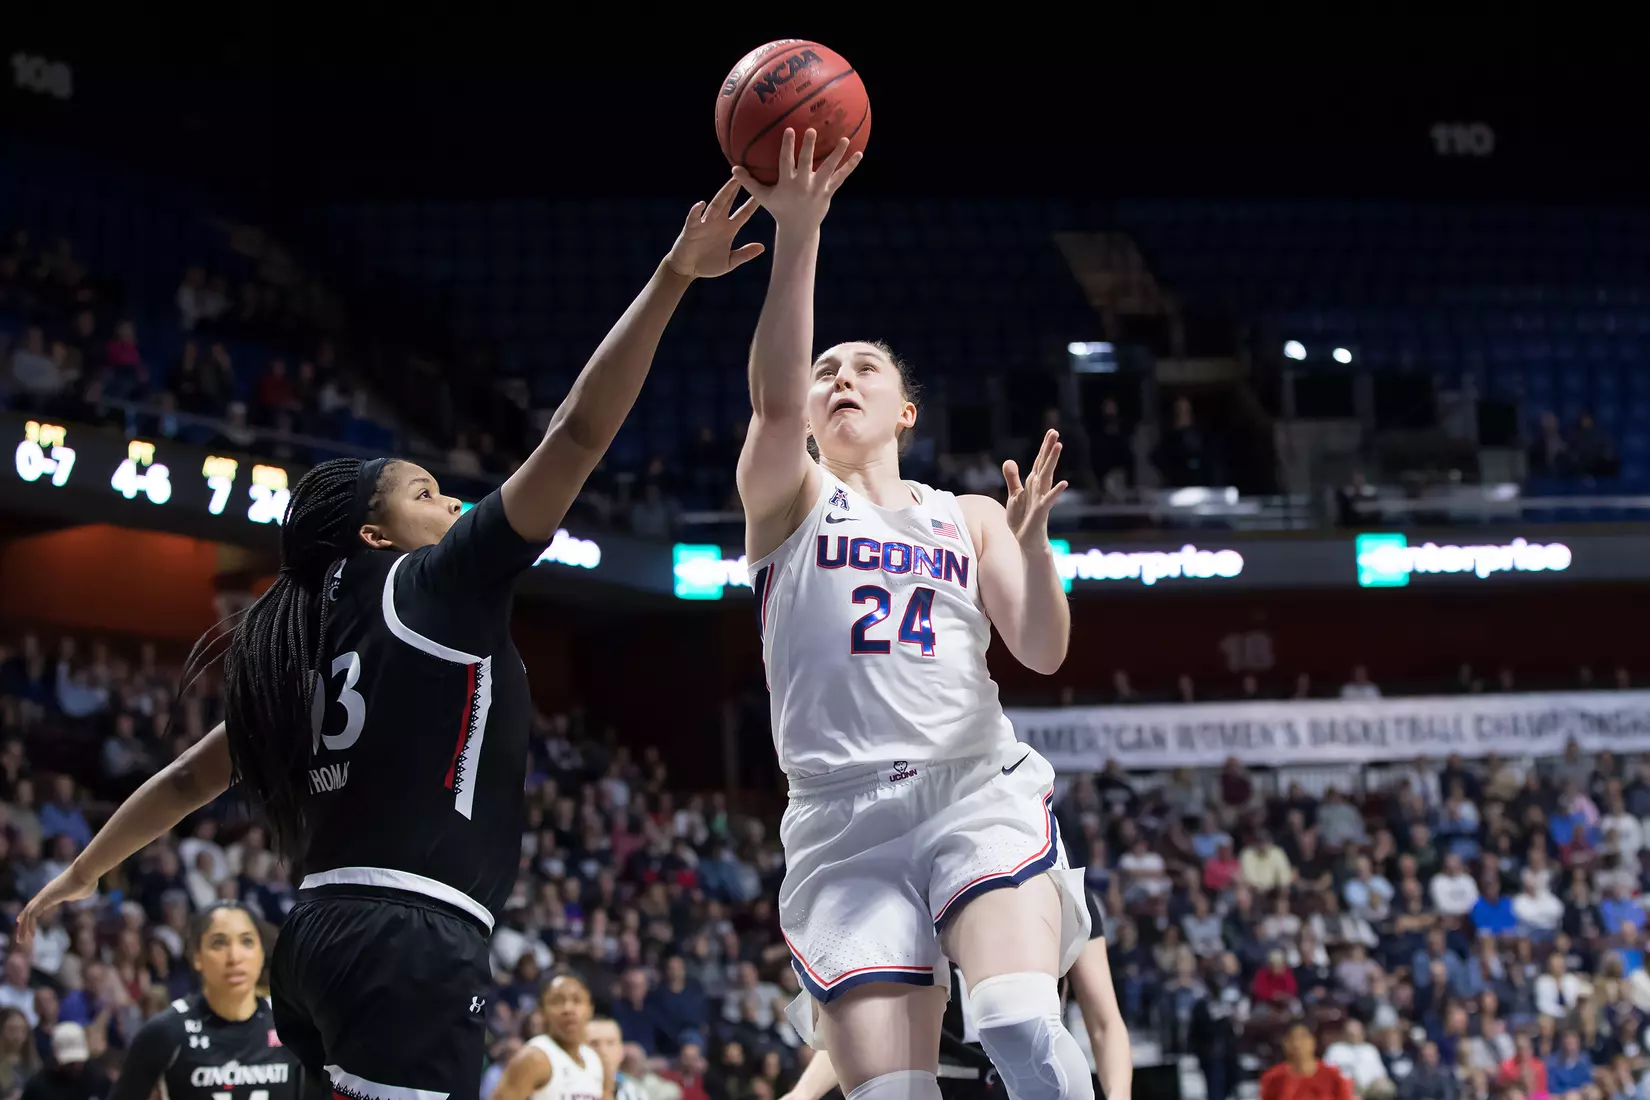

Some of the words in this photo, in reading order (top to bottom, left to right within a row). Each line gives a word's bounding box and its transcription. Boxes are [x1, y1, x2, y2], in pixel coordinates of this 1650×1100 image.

[752, 49, 824, 104] NCAA
[1430, 122, 1496, 157] 110
[15, 440, 76, 487] 0-7
[111, 458, 171, 504] 4-6
[207, 475, 232, 515] 7
[816, 535, 969, 589] UCONN
[850, 585, 936, 657] 24
[889, 768, 918, 783] UCONN
[190, 1062, 289, 1088] CINCINNATI
